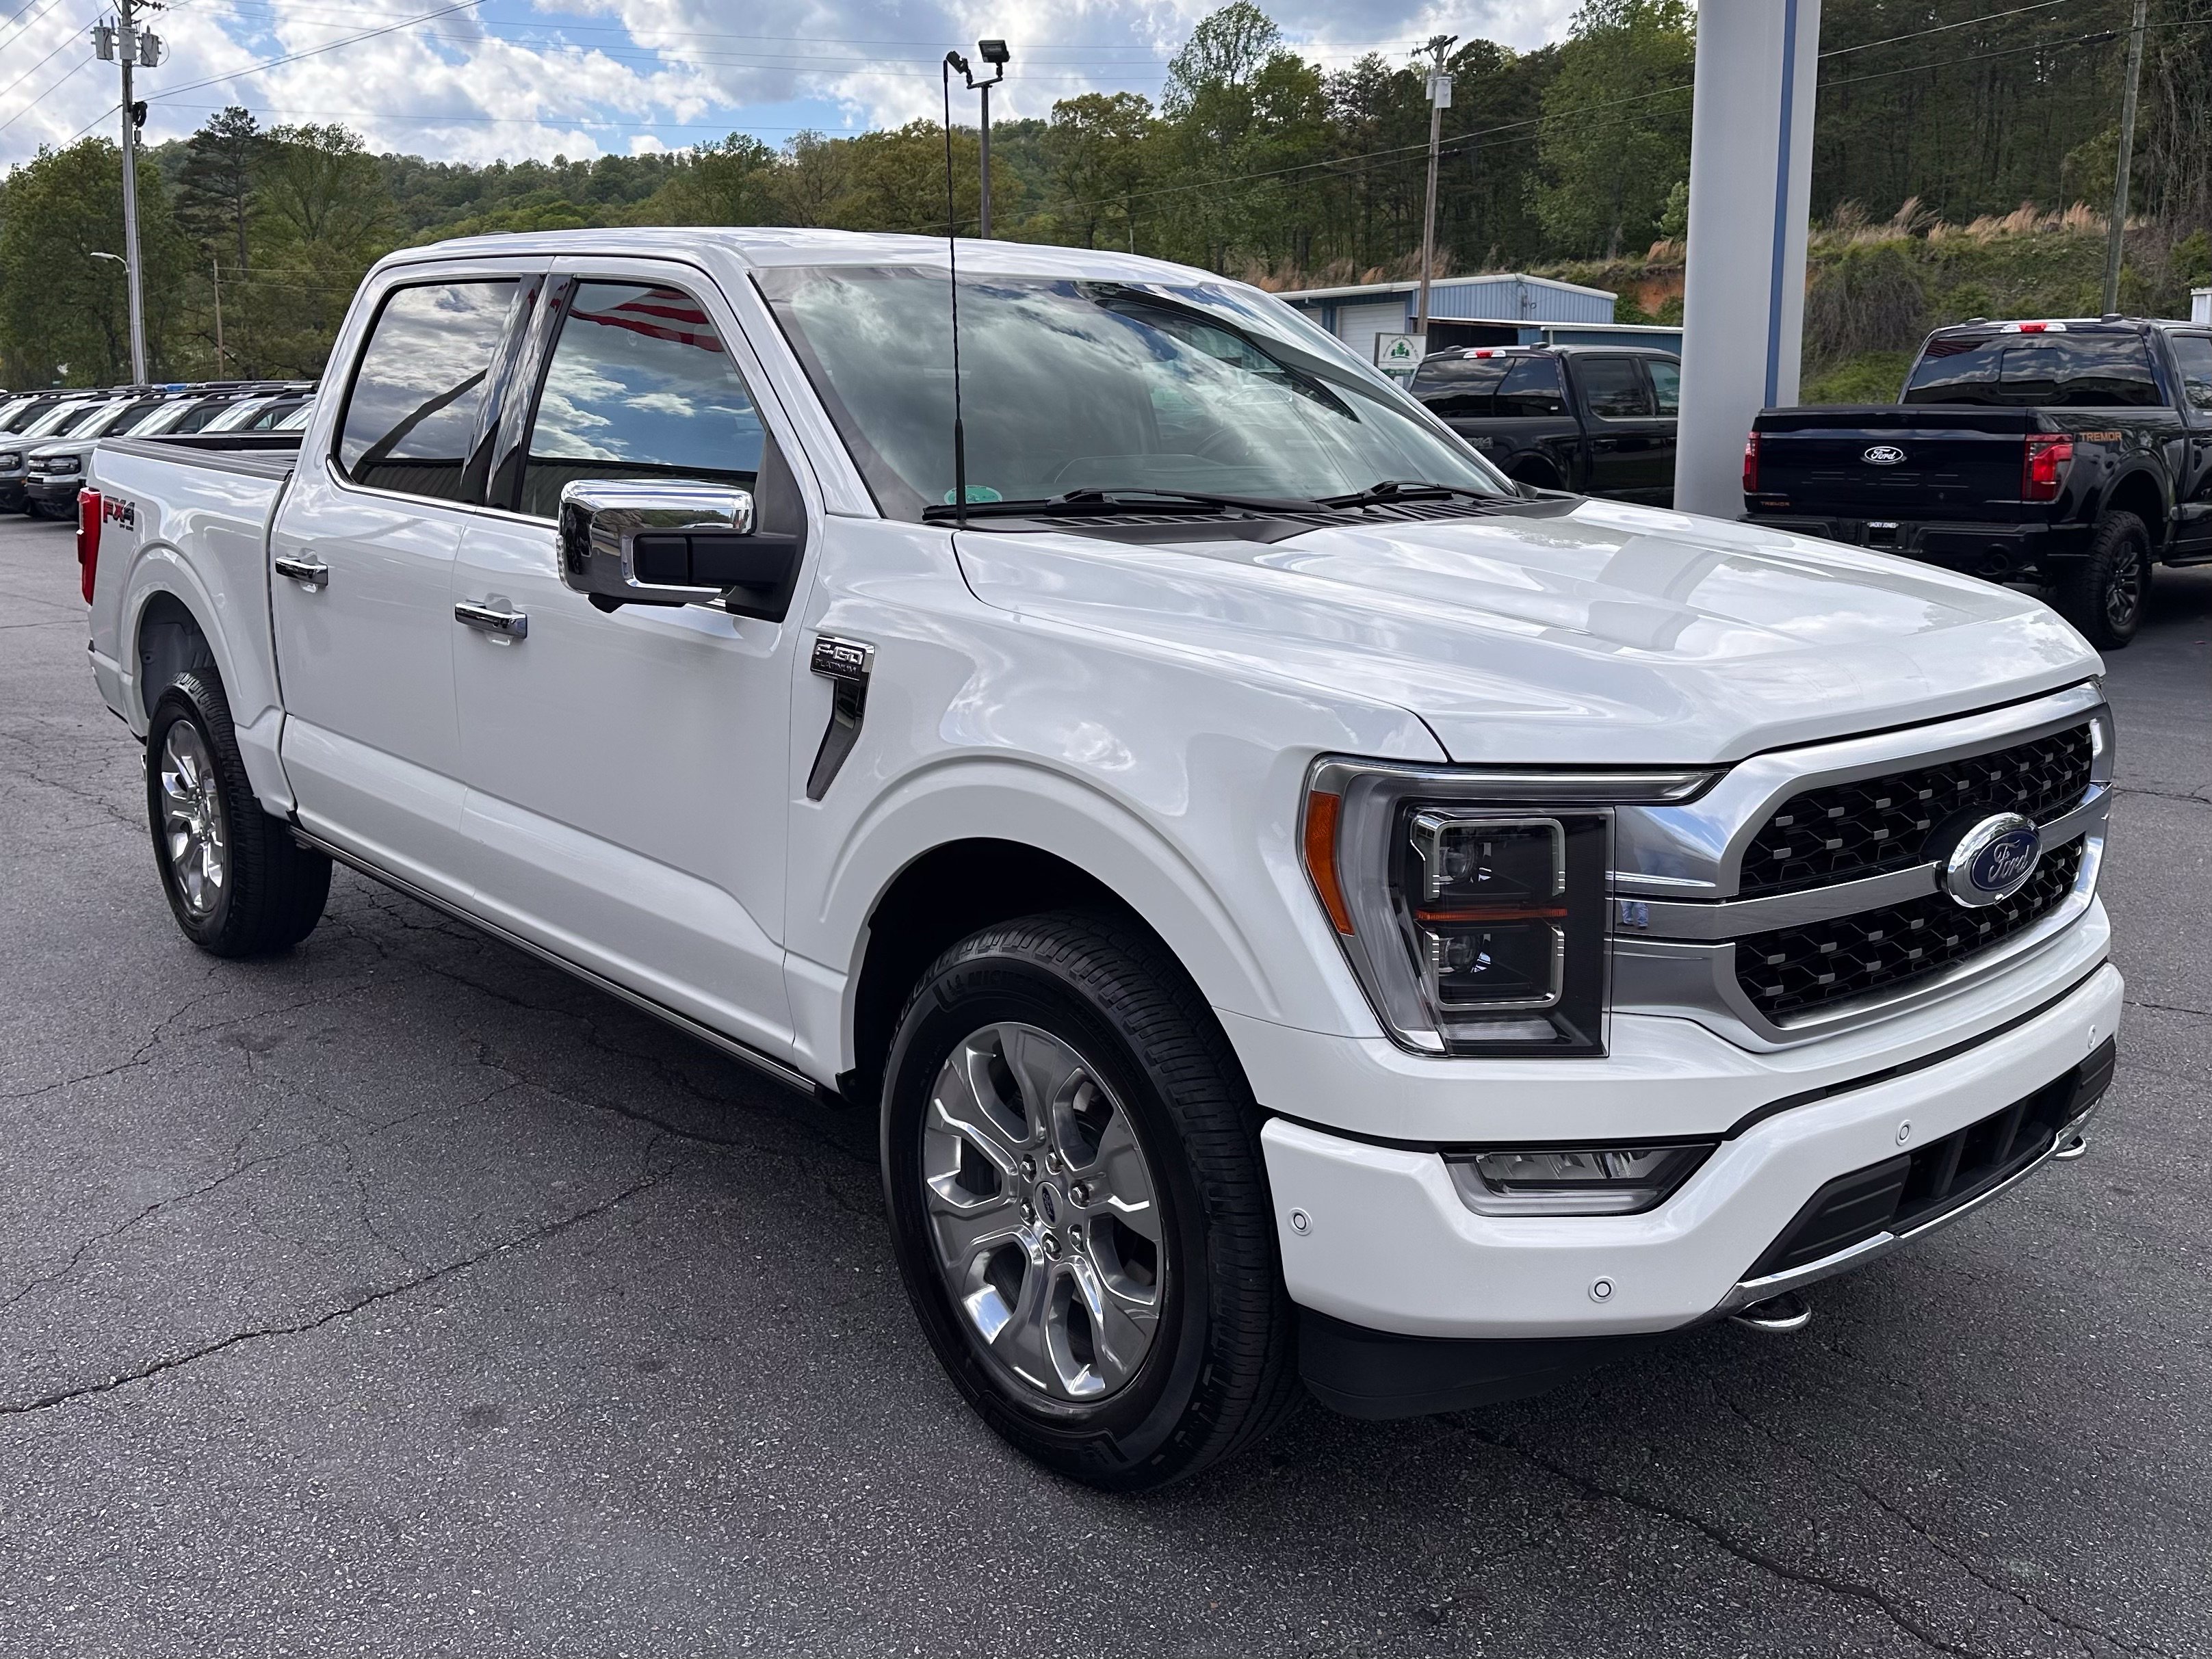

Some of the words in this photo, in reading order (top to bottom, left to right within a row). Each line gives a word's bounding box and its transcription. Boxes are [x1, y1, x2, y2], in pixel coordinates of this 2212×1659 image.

[2079, 432, 2122, 442] TREMOR
[1871, 448, 1897, 460] Ford
[103, 495, 135, 525] FX4
[815, 643, 863, 665] F-150
[1988, 839, 2030, 883] Ford
